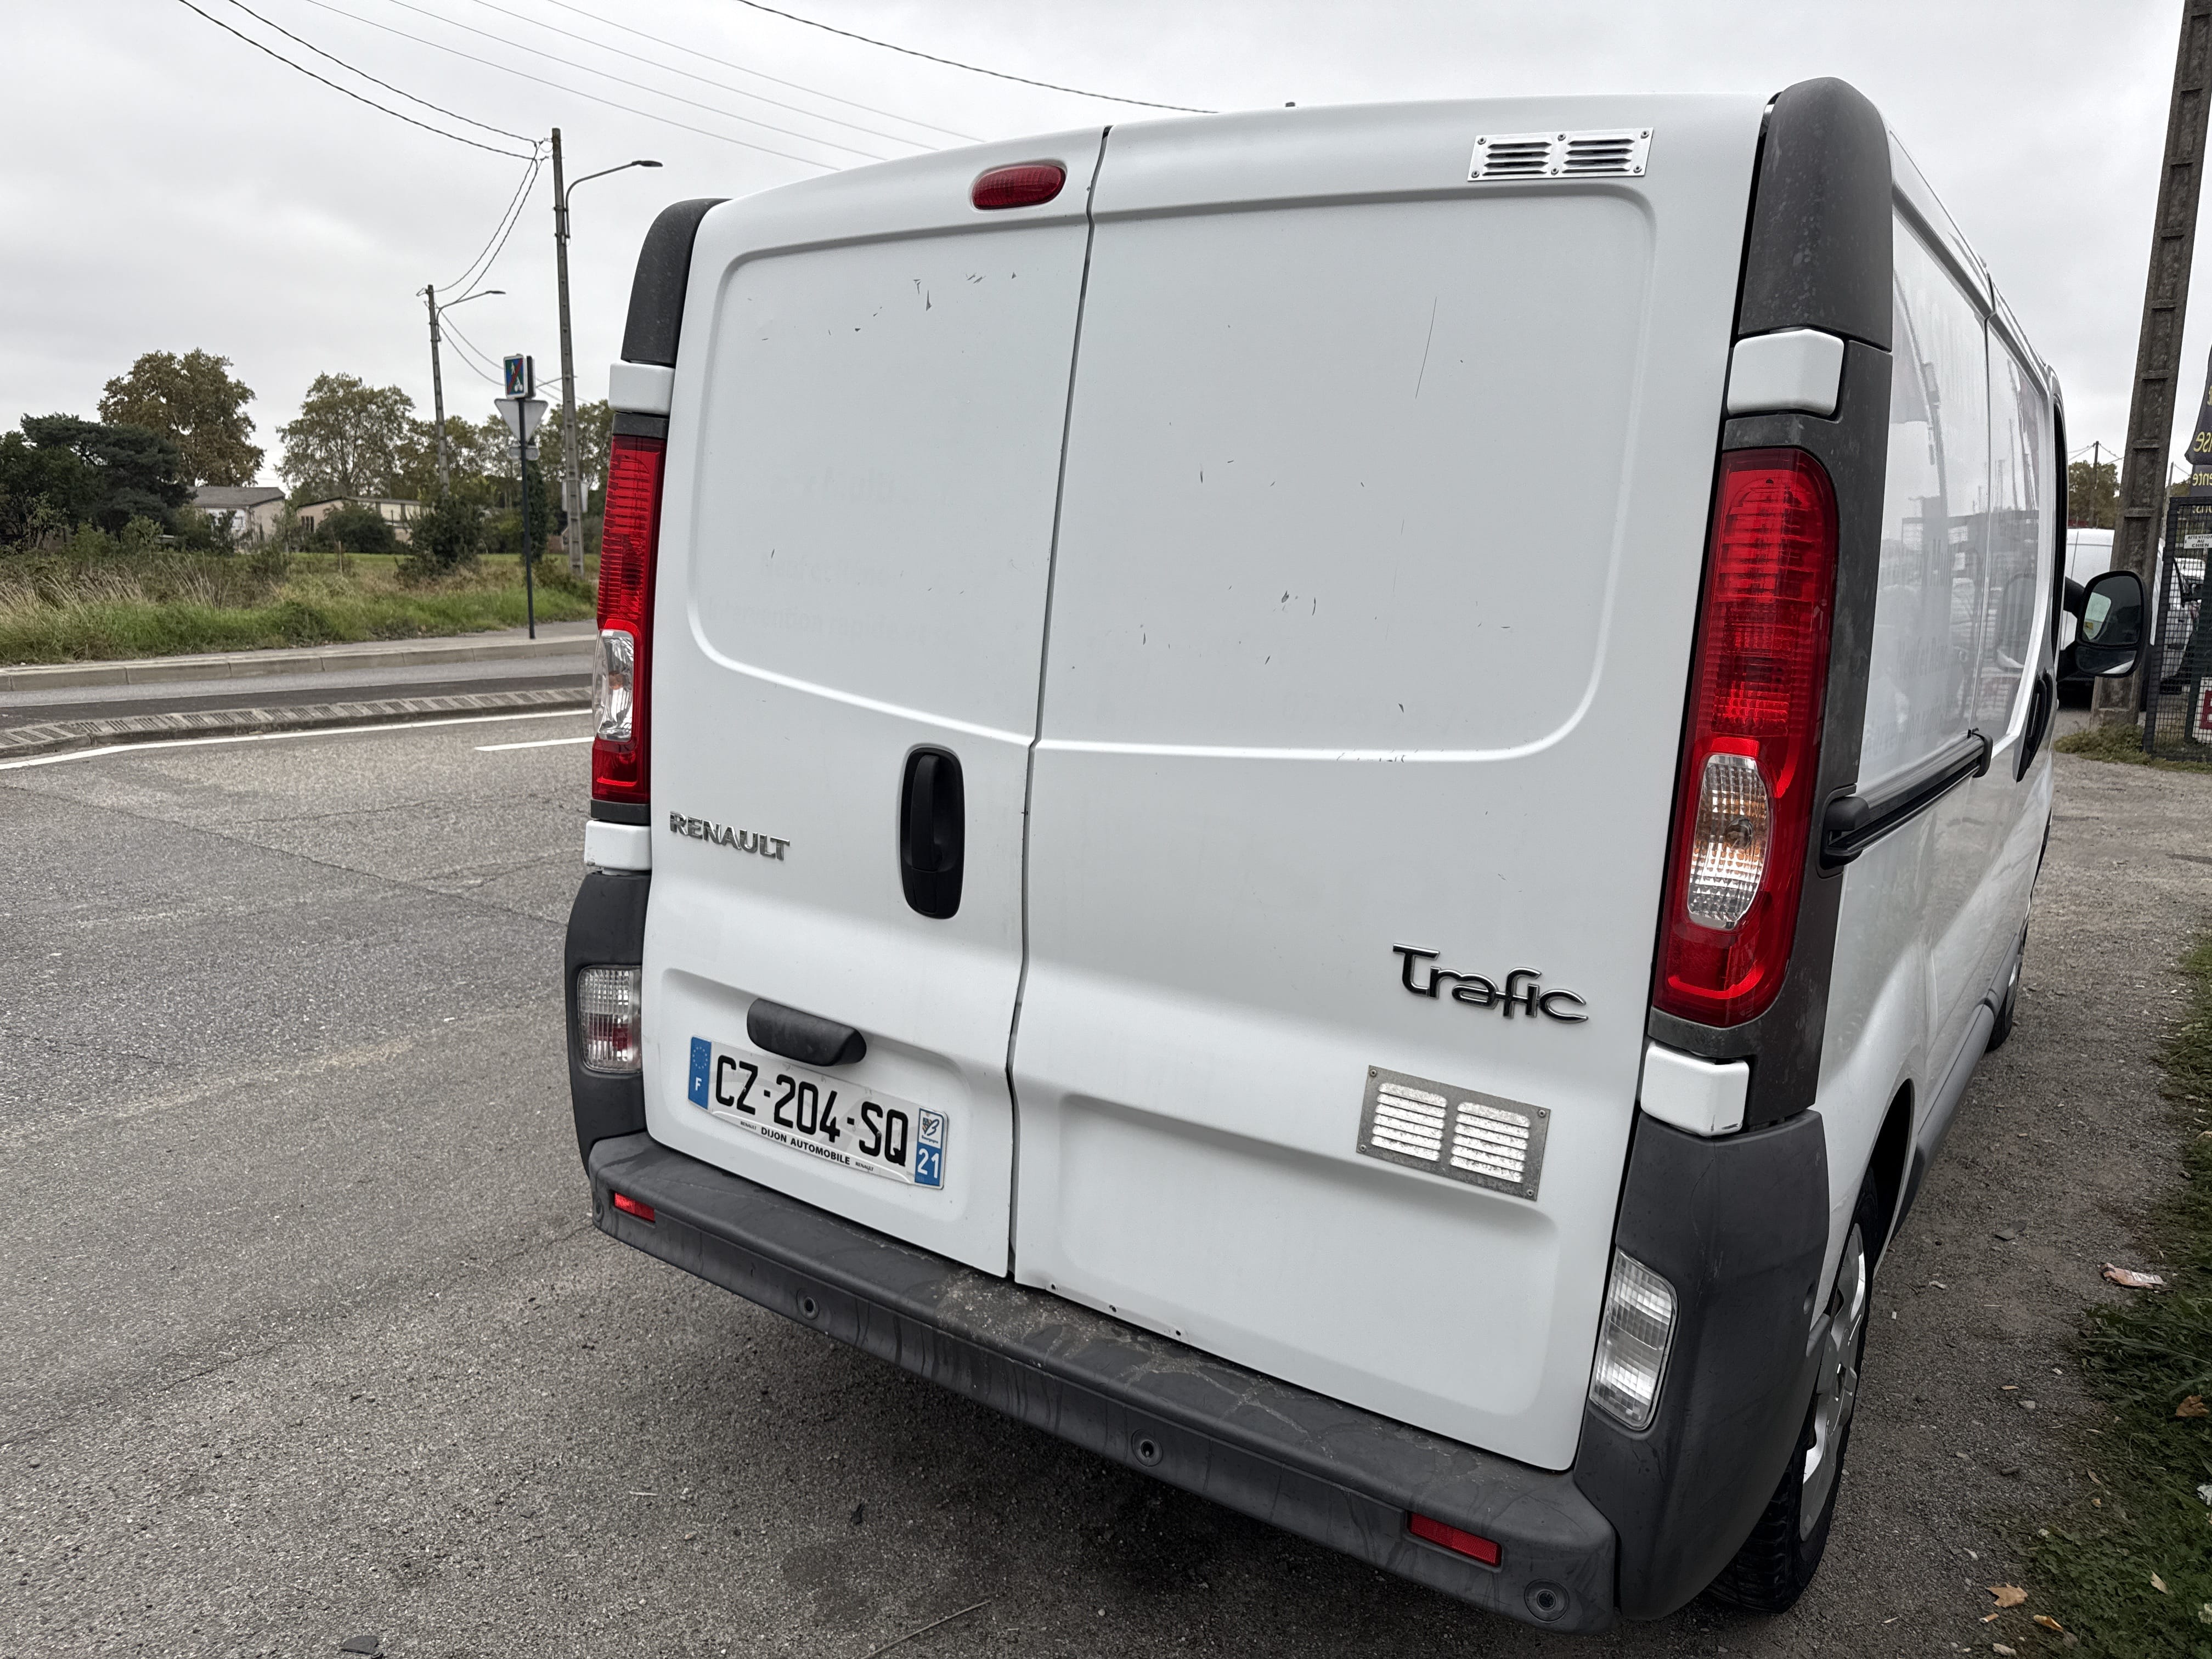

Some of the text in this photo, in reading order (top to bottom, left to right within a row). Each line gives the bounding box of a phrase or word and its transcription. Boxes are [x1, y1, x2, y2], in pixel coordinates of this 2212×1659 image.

[670, 811, 790, 860] RENAULT
[1392, 943, 1589, 1024] Trafic
[695, 1076, 702, 1092] F
[761, 1126, 787, 1143] DIJON
[791, 1137, 850, 1165] AUTOMOBILE
[917, 1148, 939, 1179] 21
